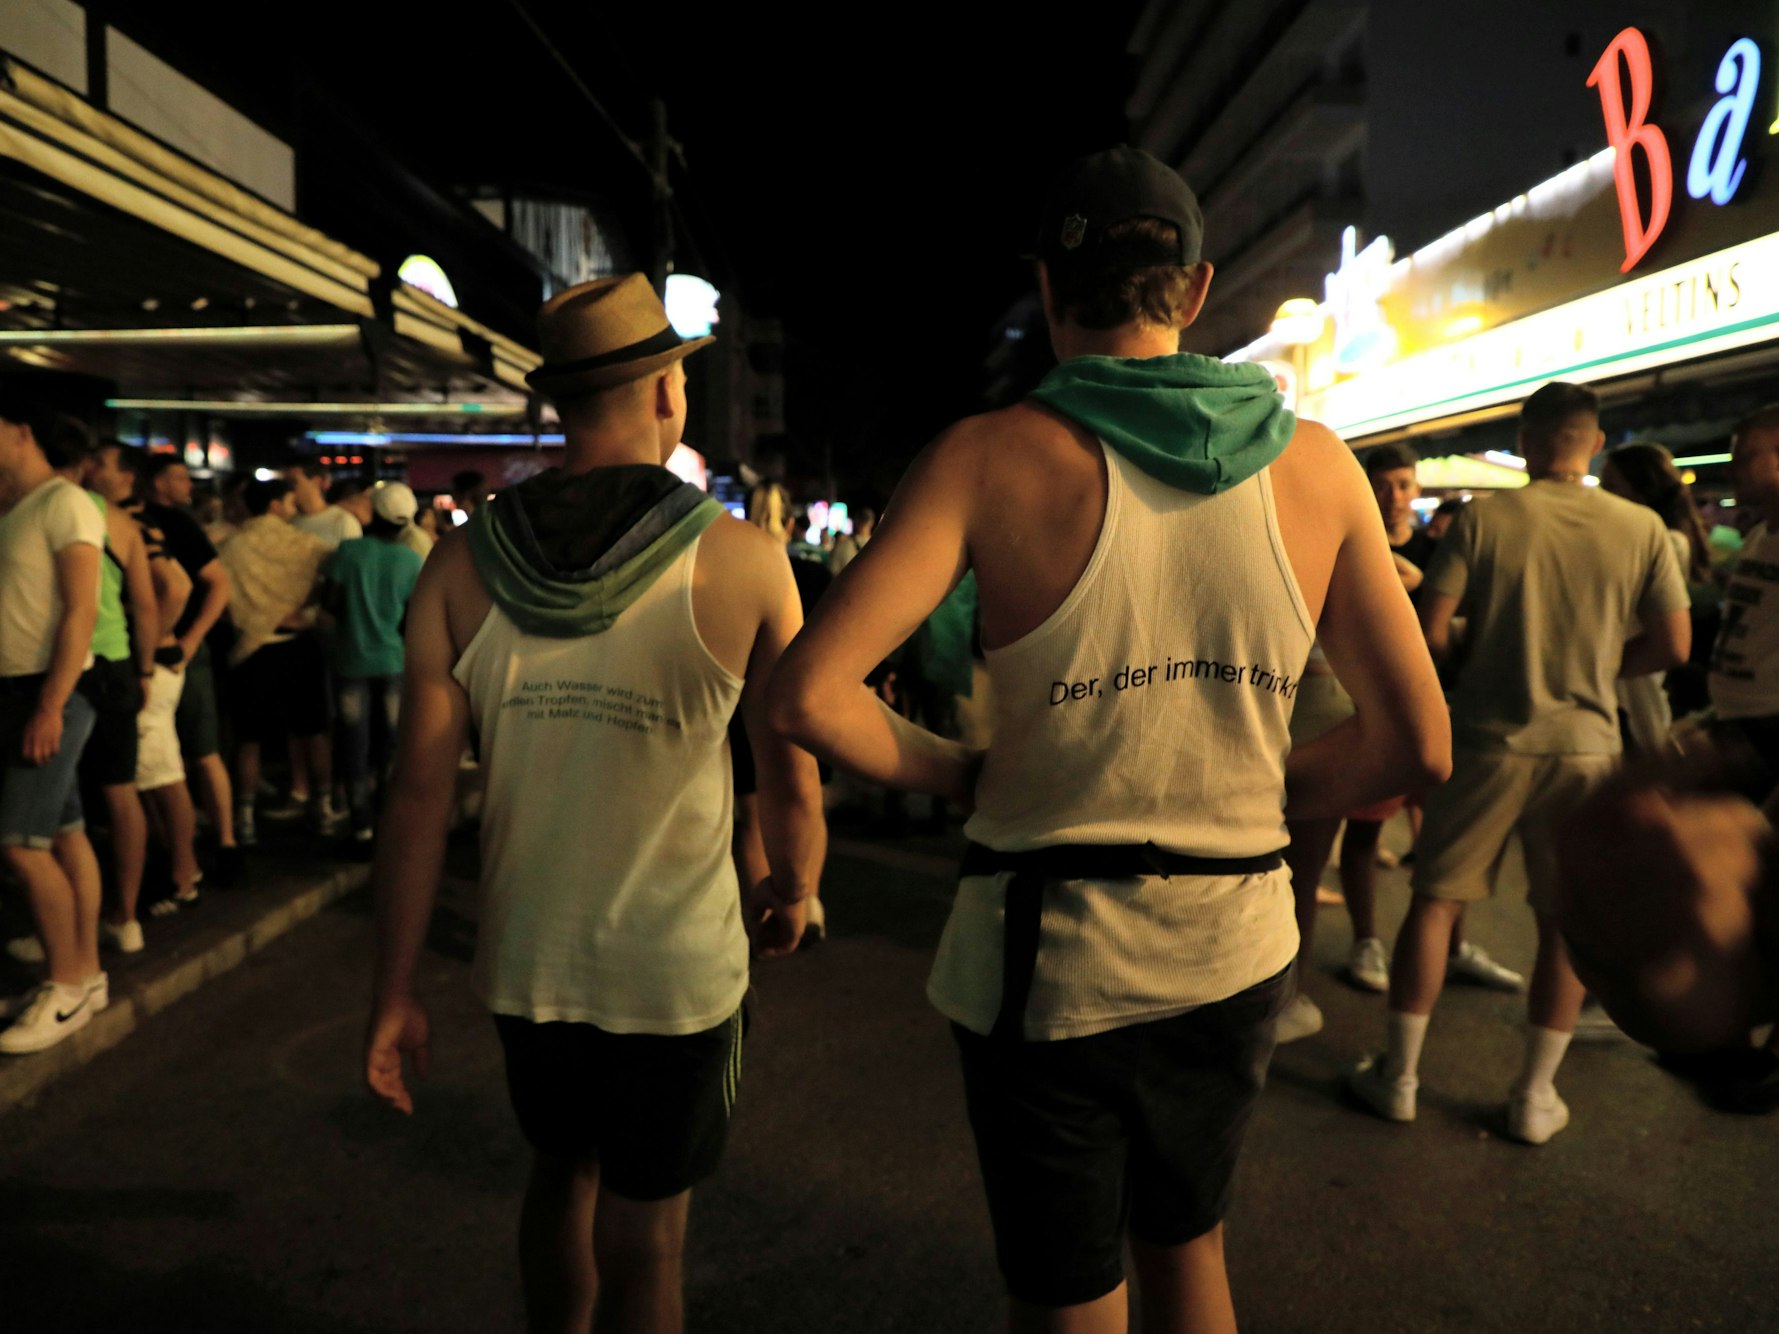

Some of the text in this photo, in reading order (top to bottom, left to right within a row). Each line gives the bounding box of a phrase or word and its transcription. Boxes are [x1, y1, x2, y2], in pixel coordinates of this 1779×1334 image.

[1586, 27, 1779, 273] Ba
[1621, 261, 1741, 337] VELTINS
[522, 679, 664, 708] Auch Wasser wird zum
[1049, 677, 1102, 706] Der,
[1114, 665, 1157, 692] der
[1165, 656, 1246, 685] immer
[527, 709, 544, 720] mit
[548, 708, 580, 719] Malz
[592, 697, 633, 714] mischt
